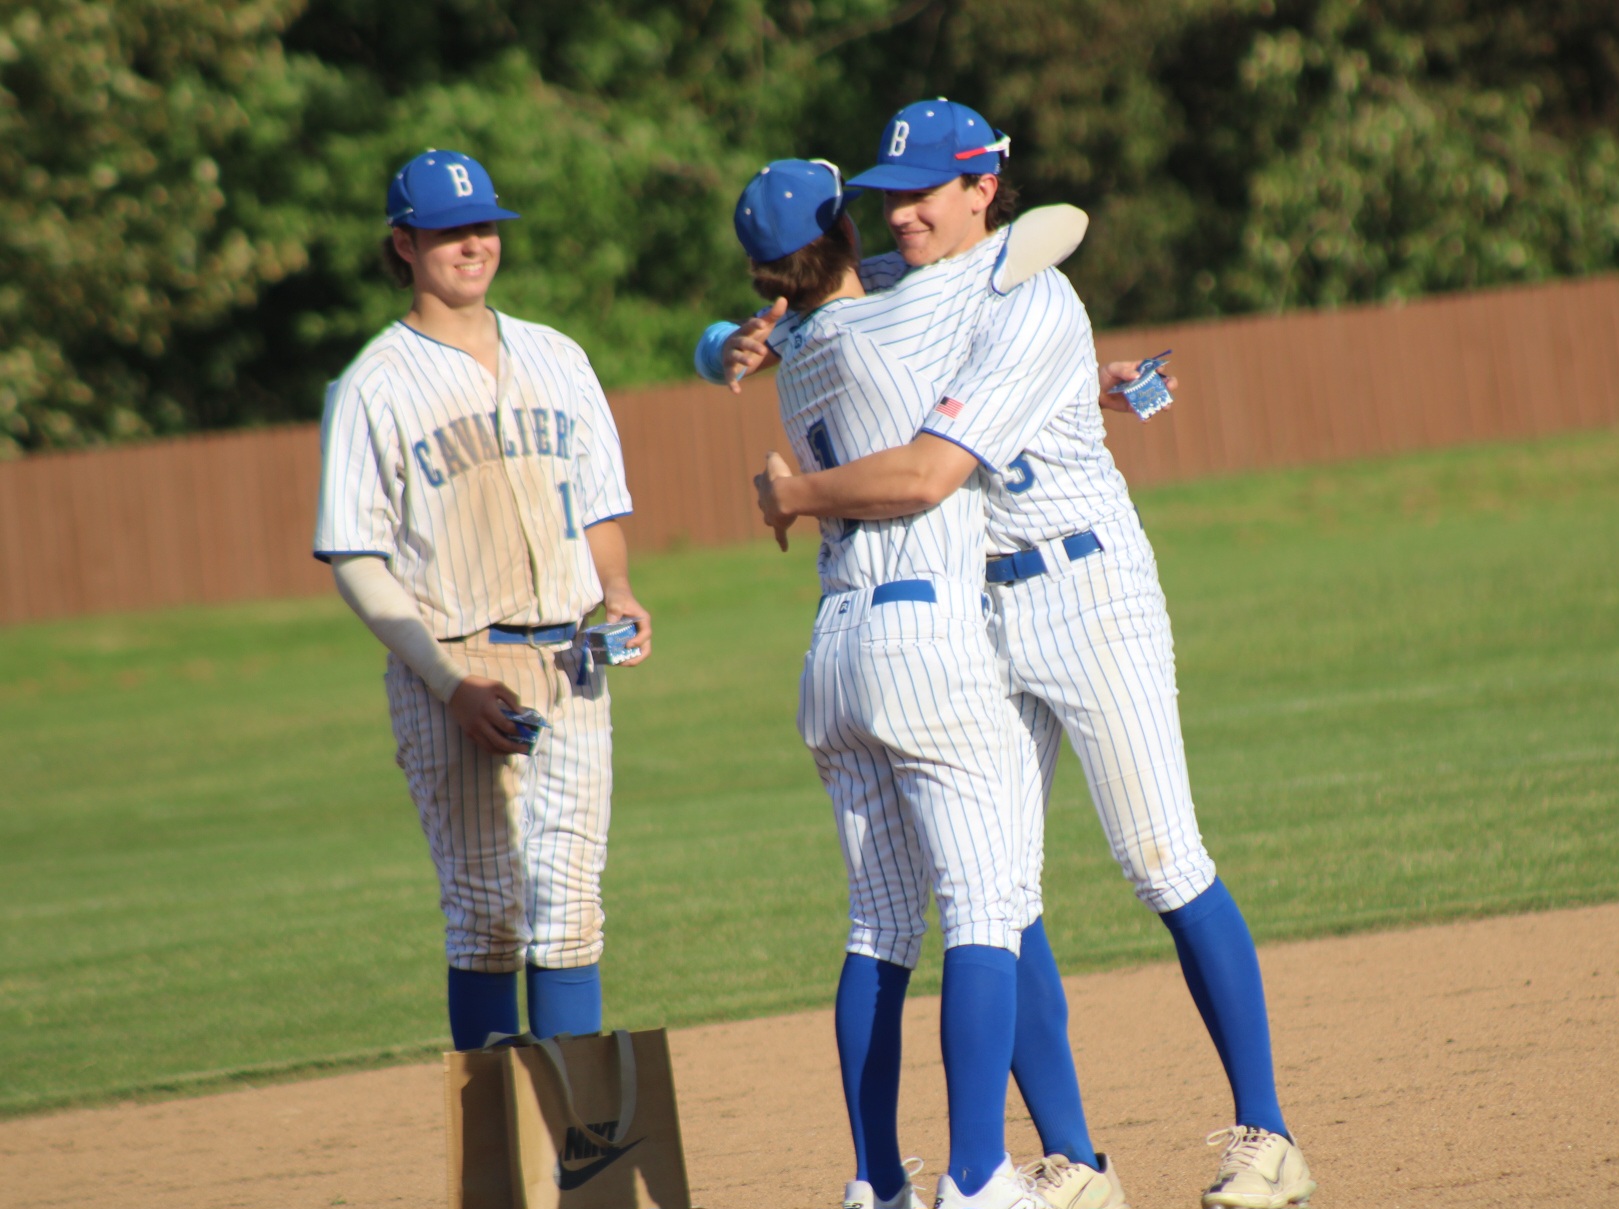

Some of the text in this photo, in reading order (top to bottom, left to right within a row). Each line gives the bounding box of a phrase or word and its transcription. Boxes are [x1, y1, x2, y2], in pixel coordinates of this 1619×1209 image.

[887, 119, 910, 157] B
[446, 163, 474, 197] B
[413, 407, 576, 488] CAVALIER
